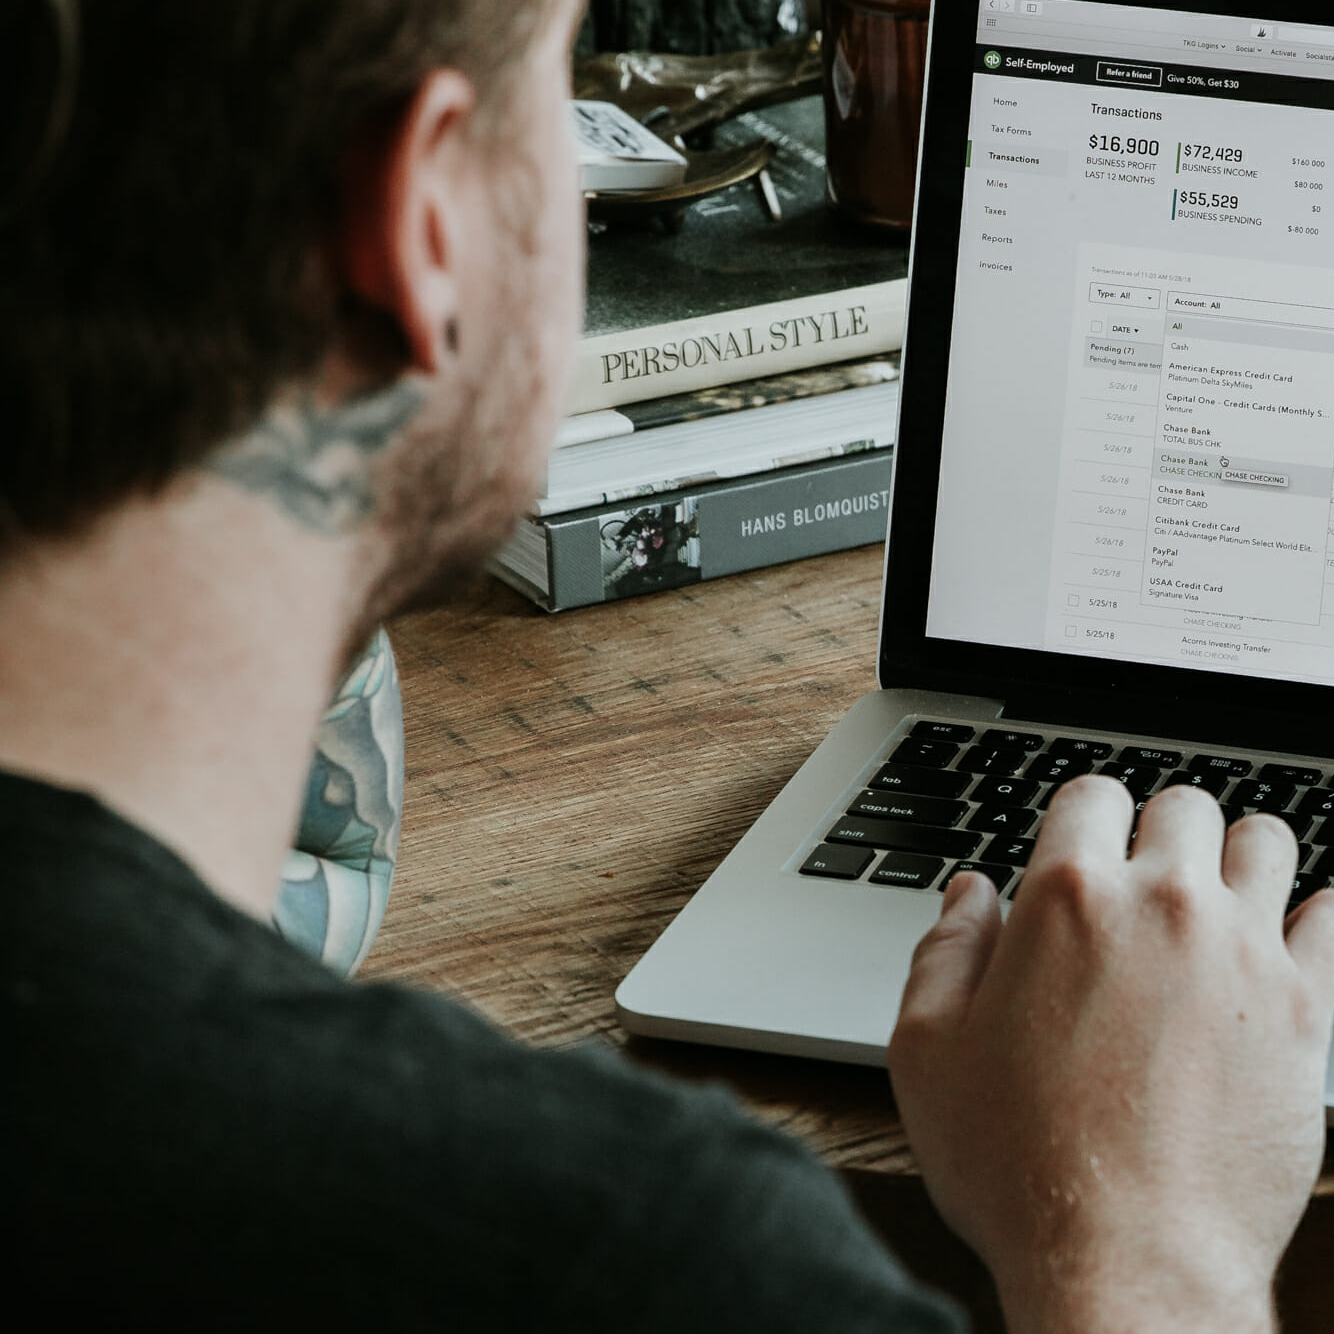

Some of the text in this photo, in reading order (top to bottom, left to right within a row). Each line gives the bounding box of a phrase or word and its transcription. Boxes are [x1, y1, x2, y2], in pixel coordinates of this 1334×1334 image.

[1005, 57, 1074, 74] Self-Employed
[1106, 68, 1125, 76] Refer
[1131, 70, 1152, 79] friend
[1167, 73, 1239, 88] Give 50%, Get $30
[993, 97, 1017, 107] Home
[1091, 103, 1162, 120] Transactions
[991, 124, 1031, 136] Tax Forms
[1089, 134, 1159, 156] $16,900
[988, 151, 1039, 164] Transactions
[1184, 144, 1242, 162] $72,429
[1086, 156, 1157, 171] BUSINESS PROFIT
[1182, 162, 1257, 178] BUSINESS INCOME
[1085, 170, 1155, 184] LAST 12 MONTHS
[986, 179, 1007, 188] Miles
[1180, 190, 1238, 209] $55,529
[984, 205, 1006, 215] Taxes
[1177, 209, 1262, 226] BUSINESS SPENDING
[981, 233, 1013, 243] Reports
[979, 260, 1012, 271] Invoices
[1097, 289, 1116, 298] Type:
[1174, 298, 1207, 307] Account:
[1112, 325, 1130, 333] DATE
[1172, 322, 1182, 330] All
[601, 305, 869, 384] PERSONAL STYLE
[1090, 343, 1134, 355] Pending (7)
[1170, 342, 1188, 351] Cash
[1168, 362, 1292, 382] American Express Credit Card
[1167, 372, 1252, 389] Platinum Delta SkyMiles
[1165, 404, 1193, 413] Venture
[1163, 423, 1210, 435] Chase Bank
[1162, 434, 1221, 448] TOTAL BUS CHK
[1160, 454, 1208, 466] Chase Bank
[1225, 471, 1284, 483] CHASE CHECKING
[1158, 485, 1205, 497] Chase Bank
[1156, 496, 1208, 508] CREDIT CARD
[740, 491, 890, 537] HANS BLOMQUIST
[1155, 516, 1240, 532] Citibank Credit Card
[1152, 546, 1178, 556] PayPal
[1151, 556, 1173, 567] PayPal
[1149, 577, 1223, 592] USAA Credit Card
[1148, 588, 1198, 600] Signature Visa
[1088, 598, 1117, 608] 5/25/18
[1086, 629, 1114, 639] 5/25/18
[1181, 636, 1271, 653] Acorns Investing Transfer
[932, 724, 952, 732] esc
[882, 775, 902, 785] tab
[860, 803, 915, 816] caps lock
[838, 828, 865, 839] shift
[878, 869, 921, 880] control
